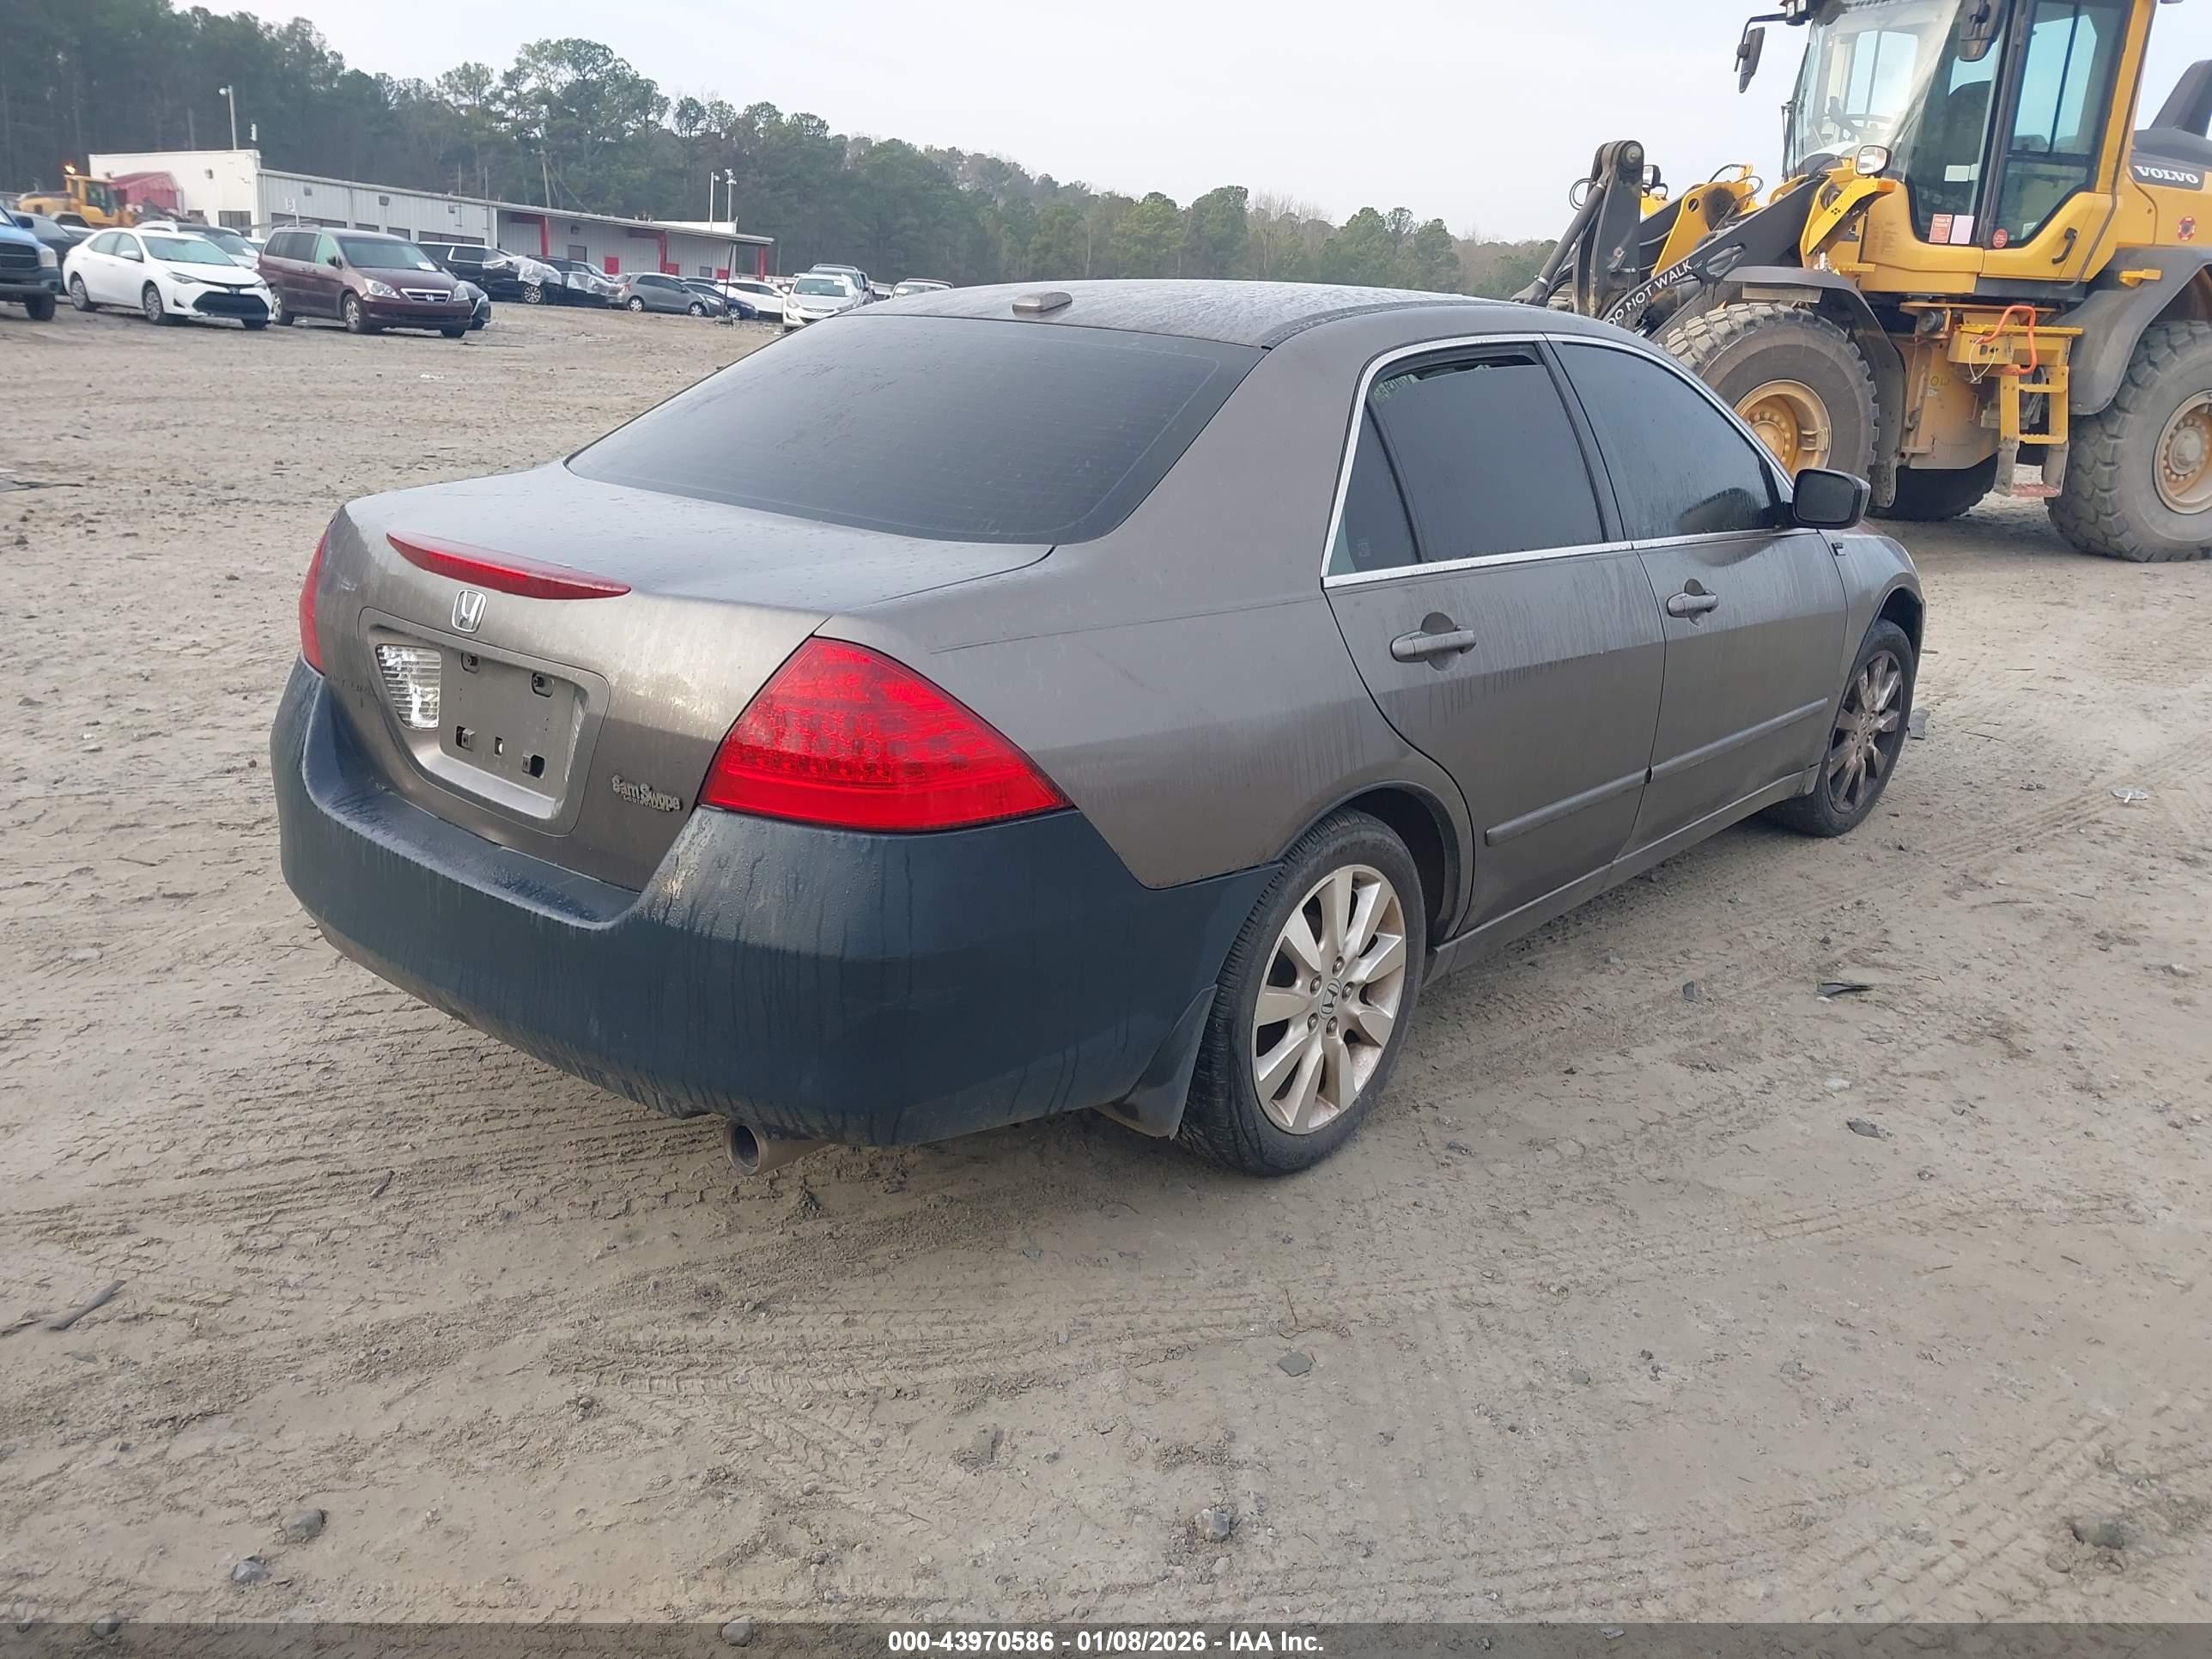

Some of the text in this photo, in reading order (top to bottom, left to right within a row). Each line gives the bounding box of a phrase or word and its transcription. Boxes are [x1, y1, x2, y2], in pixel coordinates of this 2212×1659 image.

[2134, 165, 2199, 184] VOLVO
[1626, 284, 1653, 312] NOT
[1654, 259, 1693, 289] WALK
